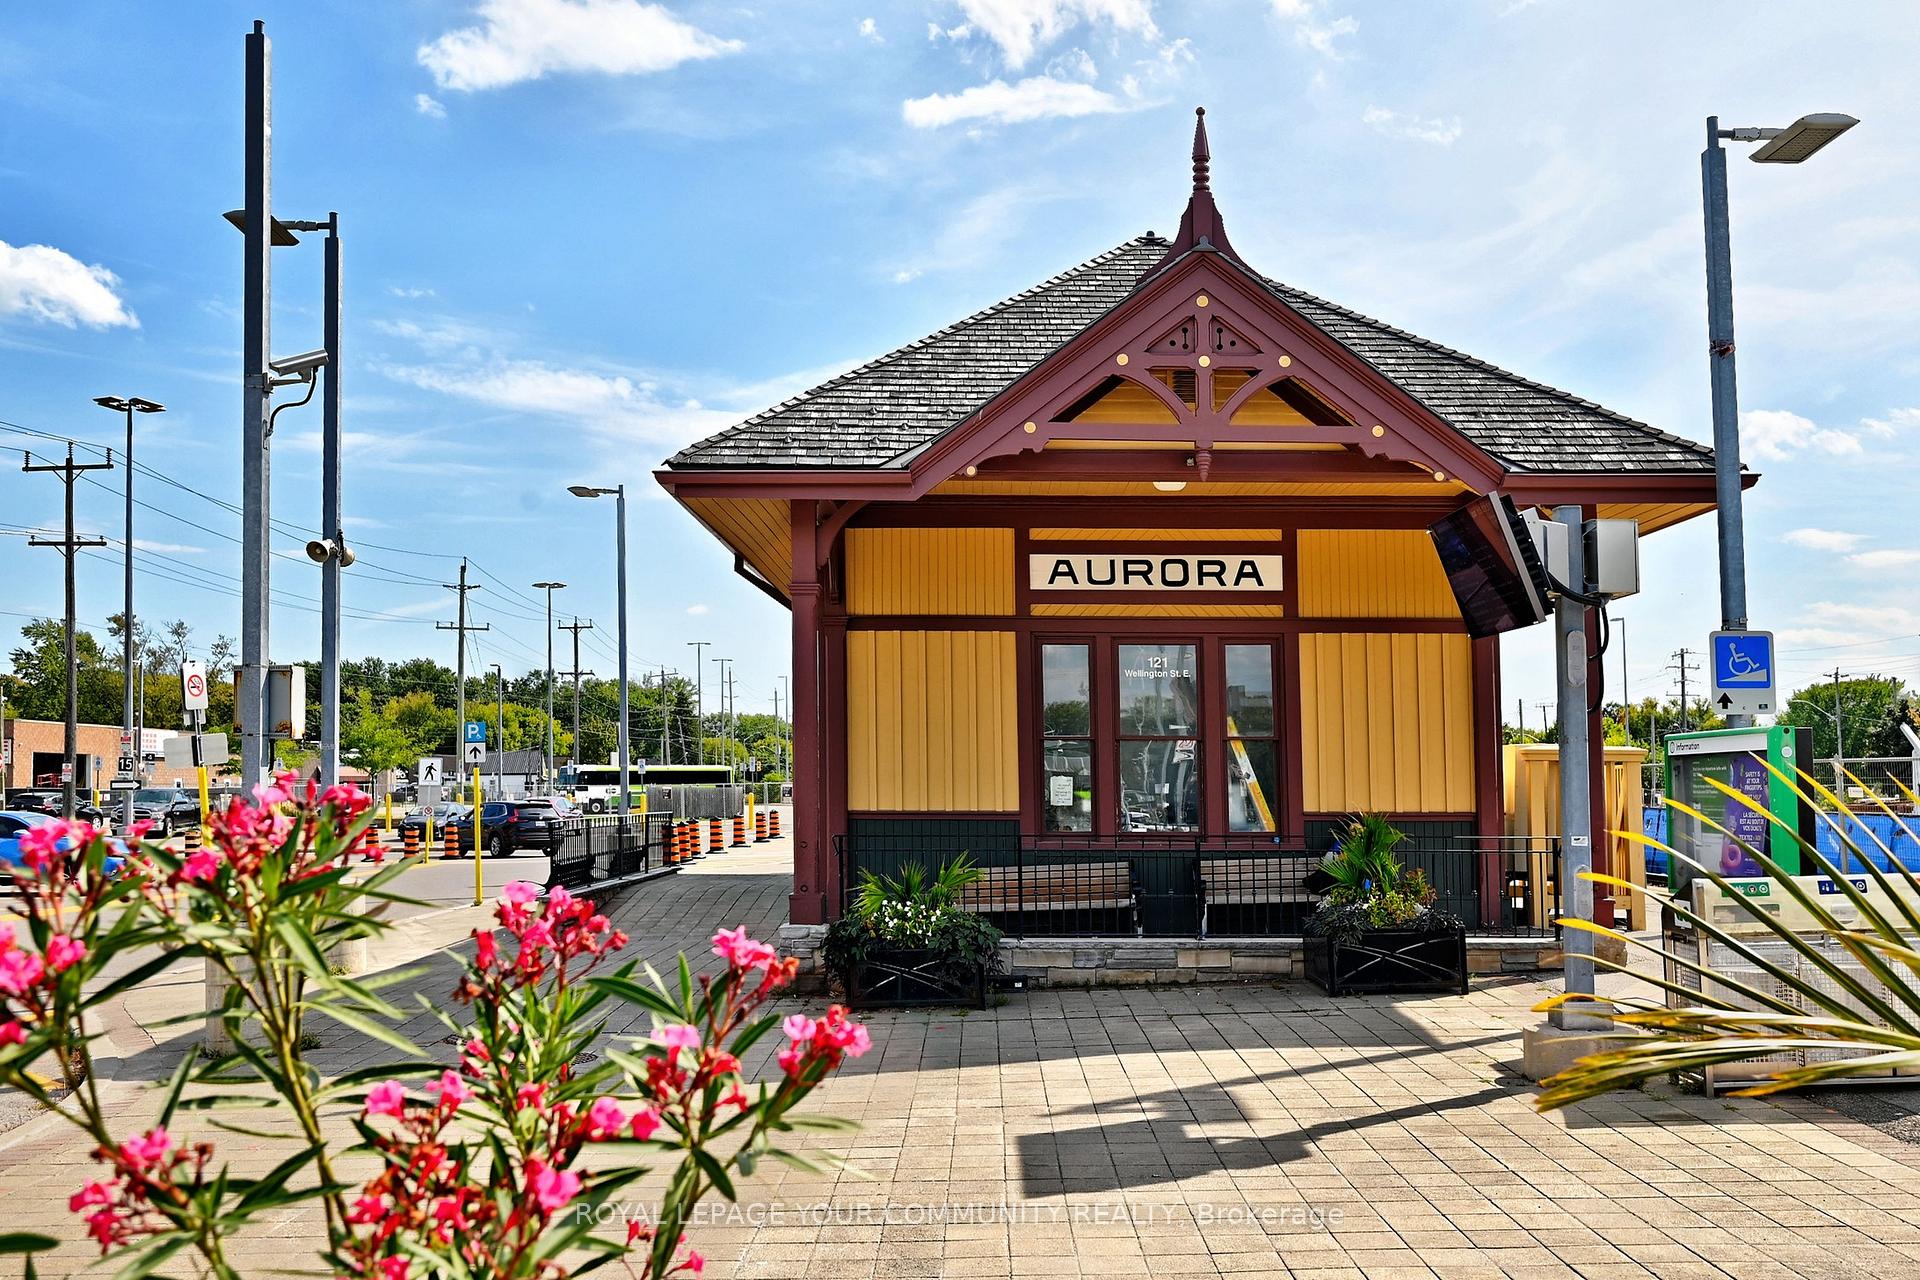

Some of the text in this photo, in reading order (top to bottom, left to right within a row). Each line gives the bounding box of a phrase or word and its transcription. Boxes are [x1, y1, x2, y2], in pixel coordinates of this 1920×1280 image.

[1048, 559, 1264, 587] AURORA
[1147, 656, 1168, 668] 121
[1124, 669, 1191, 680] Wellington St. E.
[467, 724, 480, 739] P
[119, 758, 133, 770] 15
